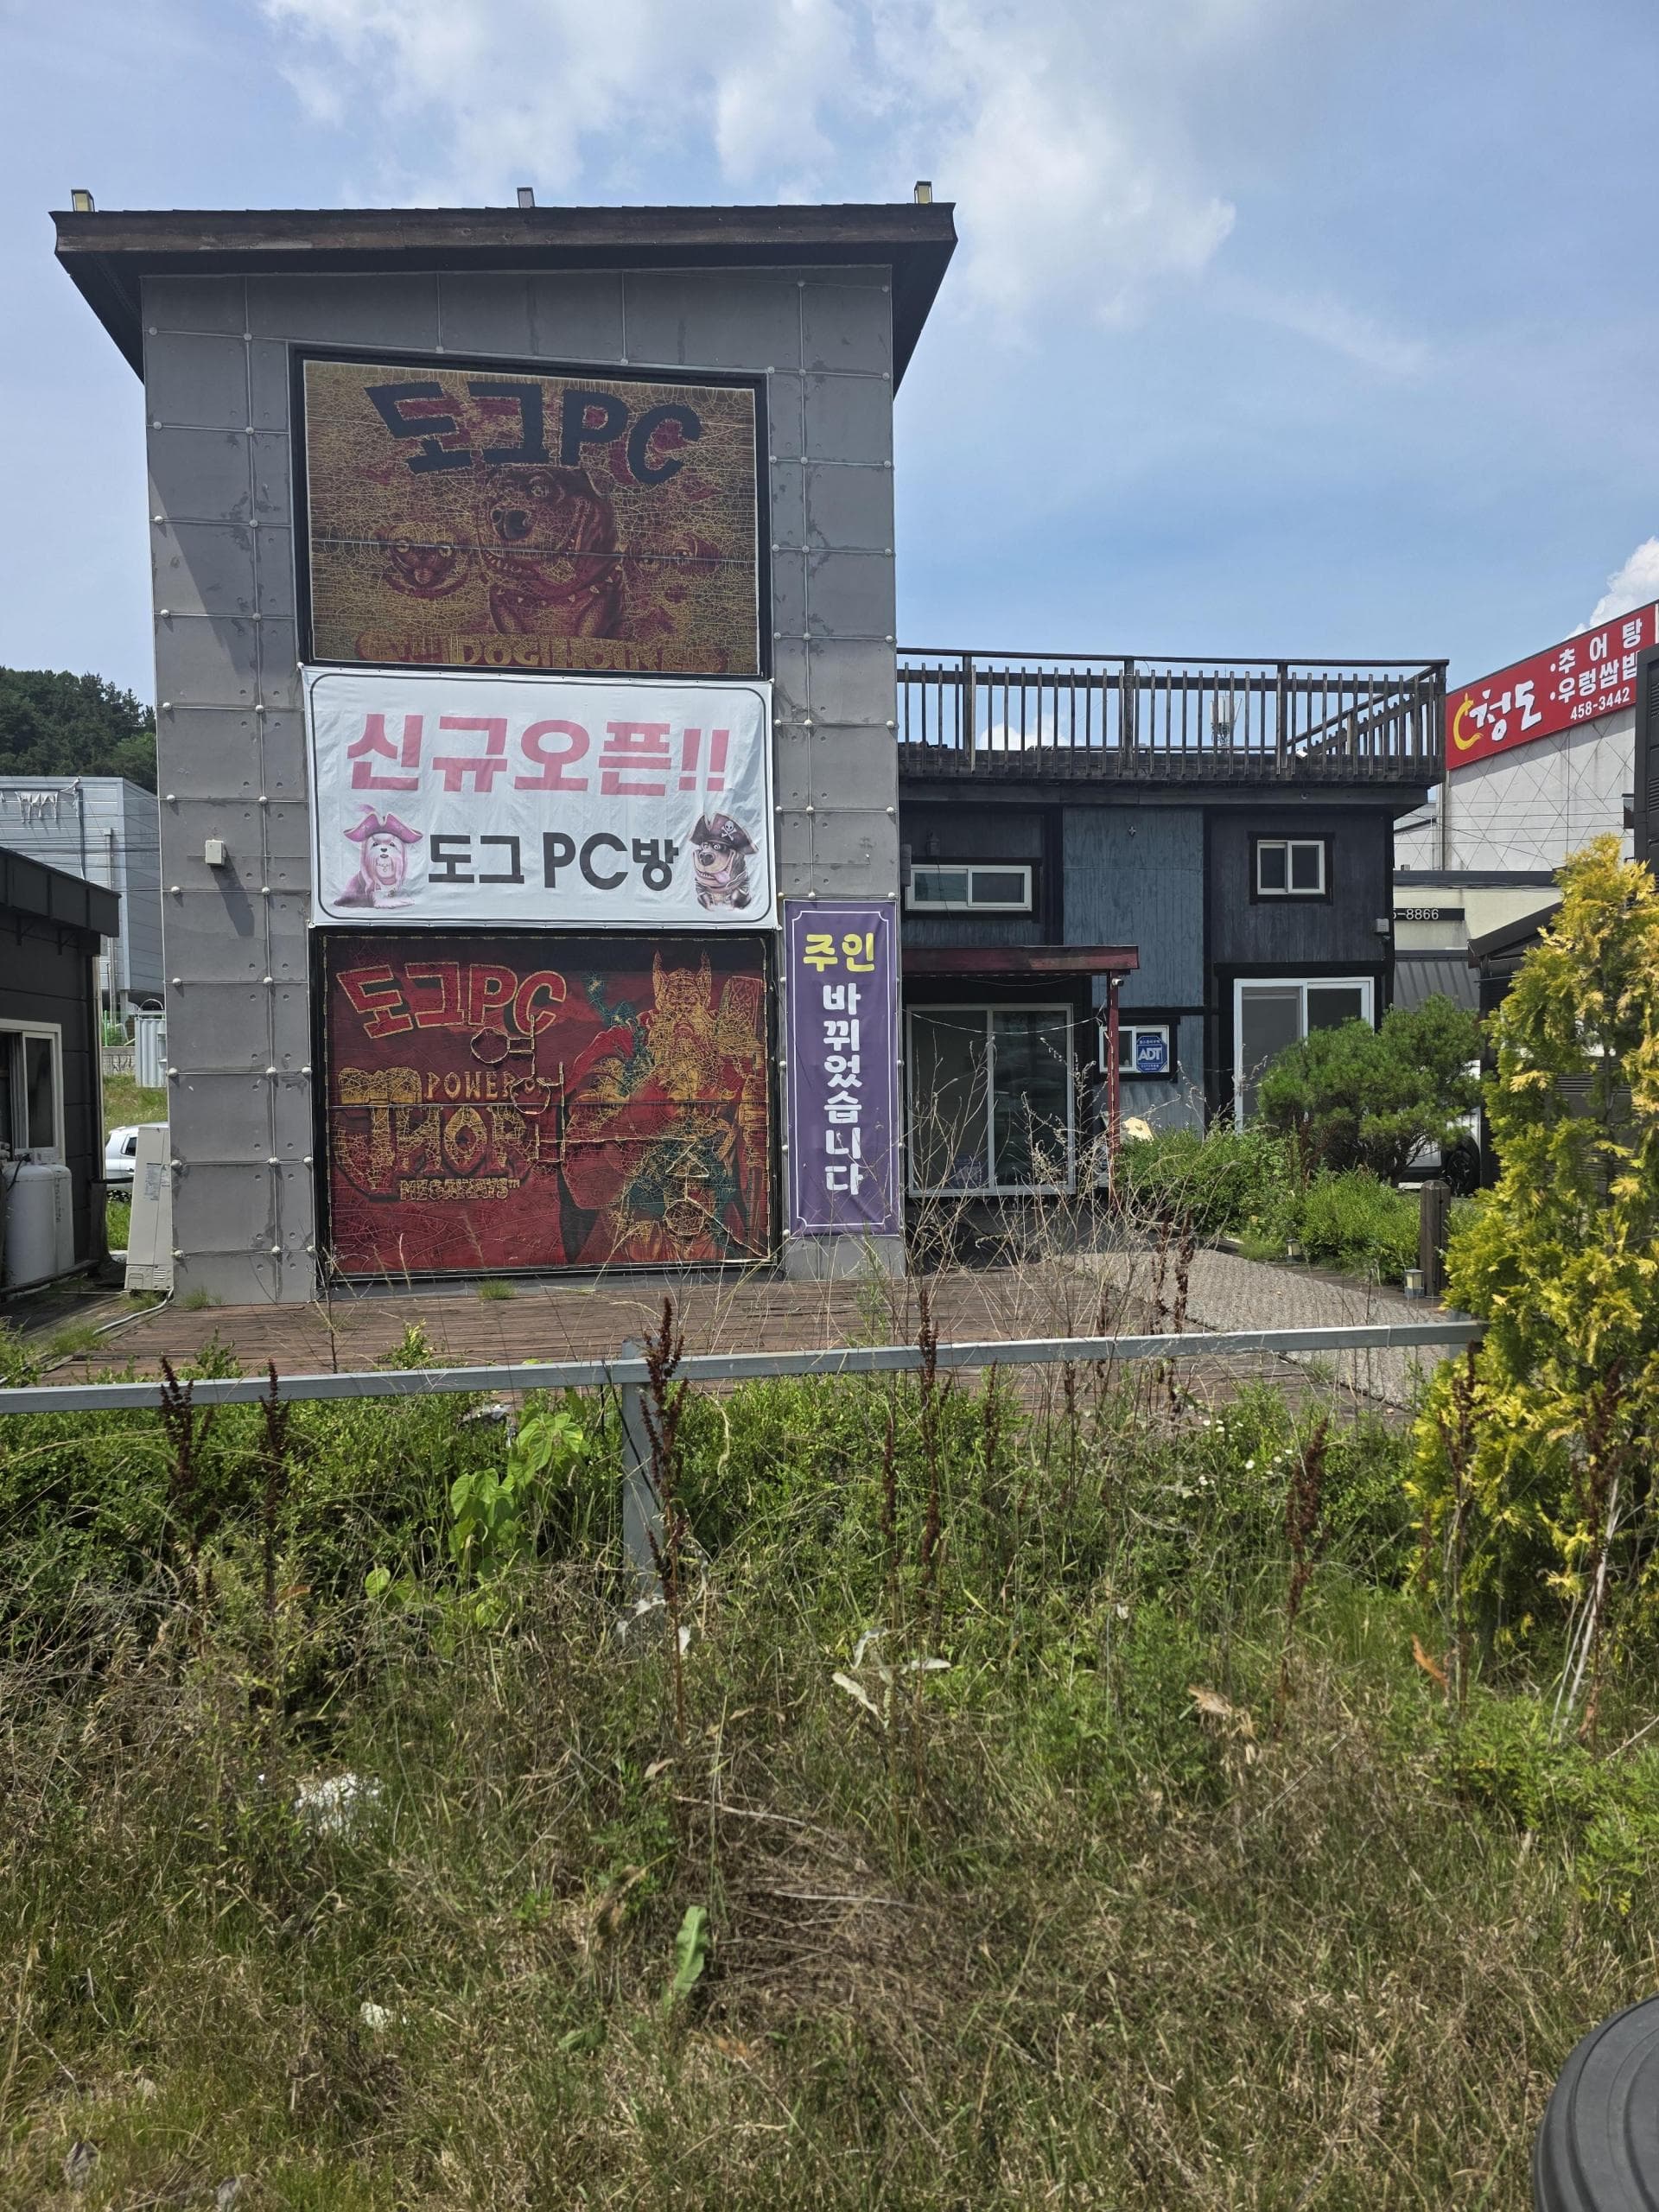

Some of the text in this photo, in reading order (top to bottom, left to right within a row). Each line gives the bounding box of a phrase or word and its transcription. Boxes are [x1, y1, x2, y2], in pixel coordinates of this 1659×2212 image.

[1469, 679, 1542, 741] 청도
[1570, 686, 1630, 721] 458-3442
[346, 713, 730, 797] 신규오픈!!
[802, 932, 875, 973] 주인
[1137, 1047, 1162, 1061] ADT
[425, 1071, 518, 1101] POWER
[822, 982, 864, 1197] 바뀌었습니다
